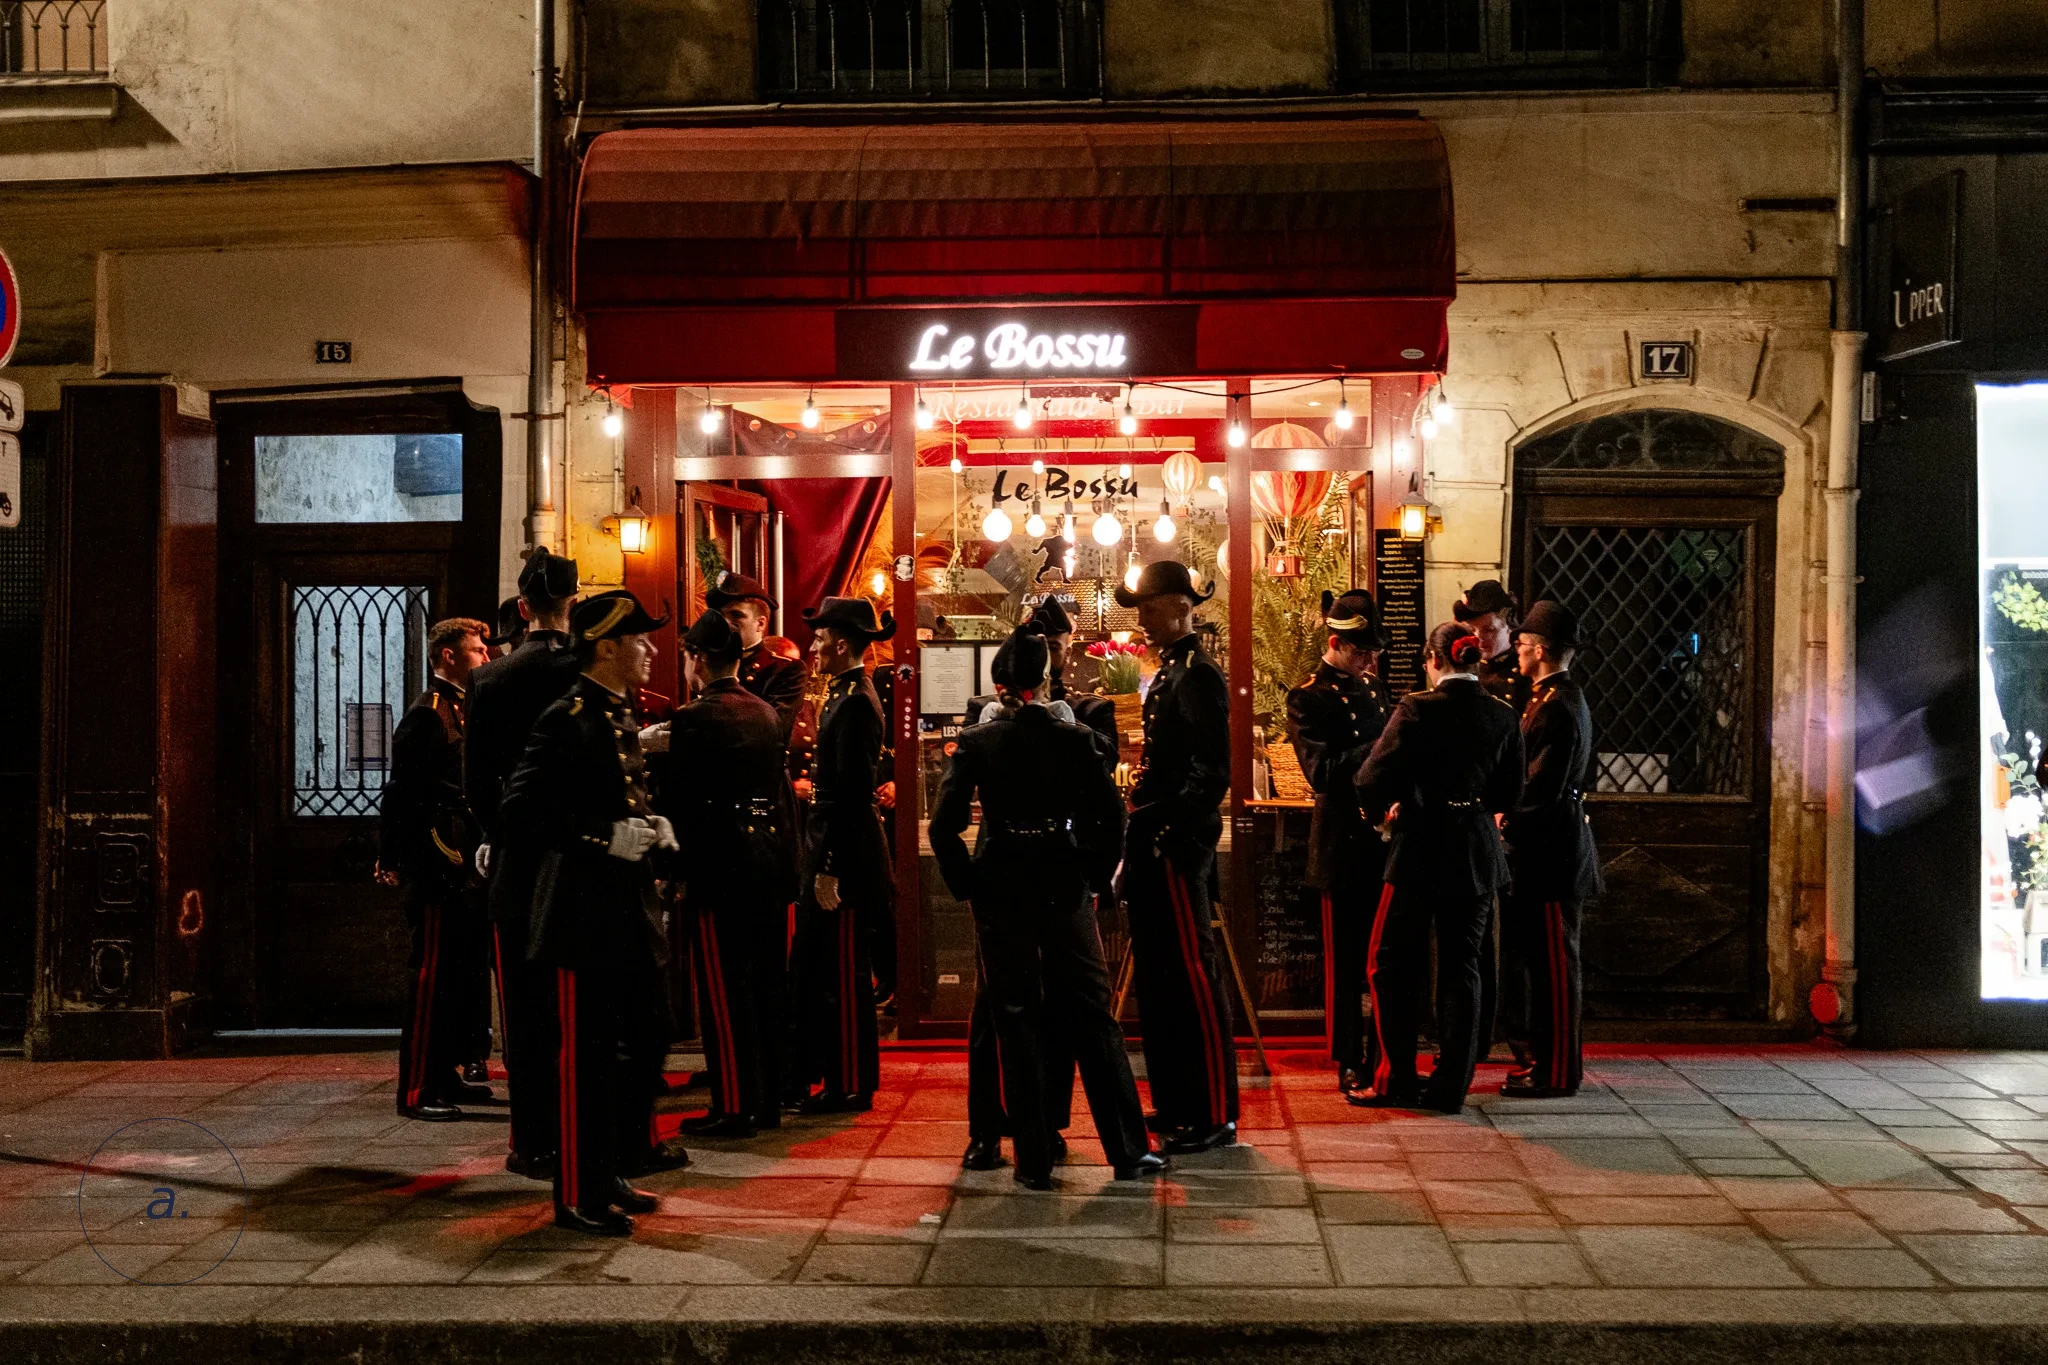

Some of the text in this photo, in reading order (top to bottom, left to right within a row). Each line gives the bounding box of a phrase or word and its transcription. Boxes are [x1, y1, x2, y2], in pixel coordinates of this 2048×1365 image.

[321, 344, 346, 361] 15
[909, 322, 1128, 371] Le Bossu
[1648, 347, 1681, 373] 17
[934, 391, 1098, 424] Restarant
[993, 467, 1139, 502] Le Bossu
[1039, 591, 1076, 605] Bssu
[942, 725, 957, 738] LES
